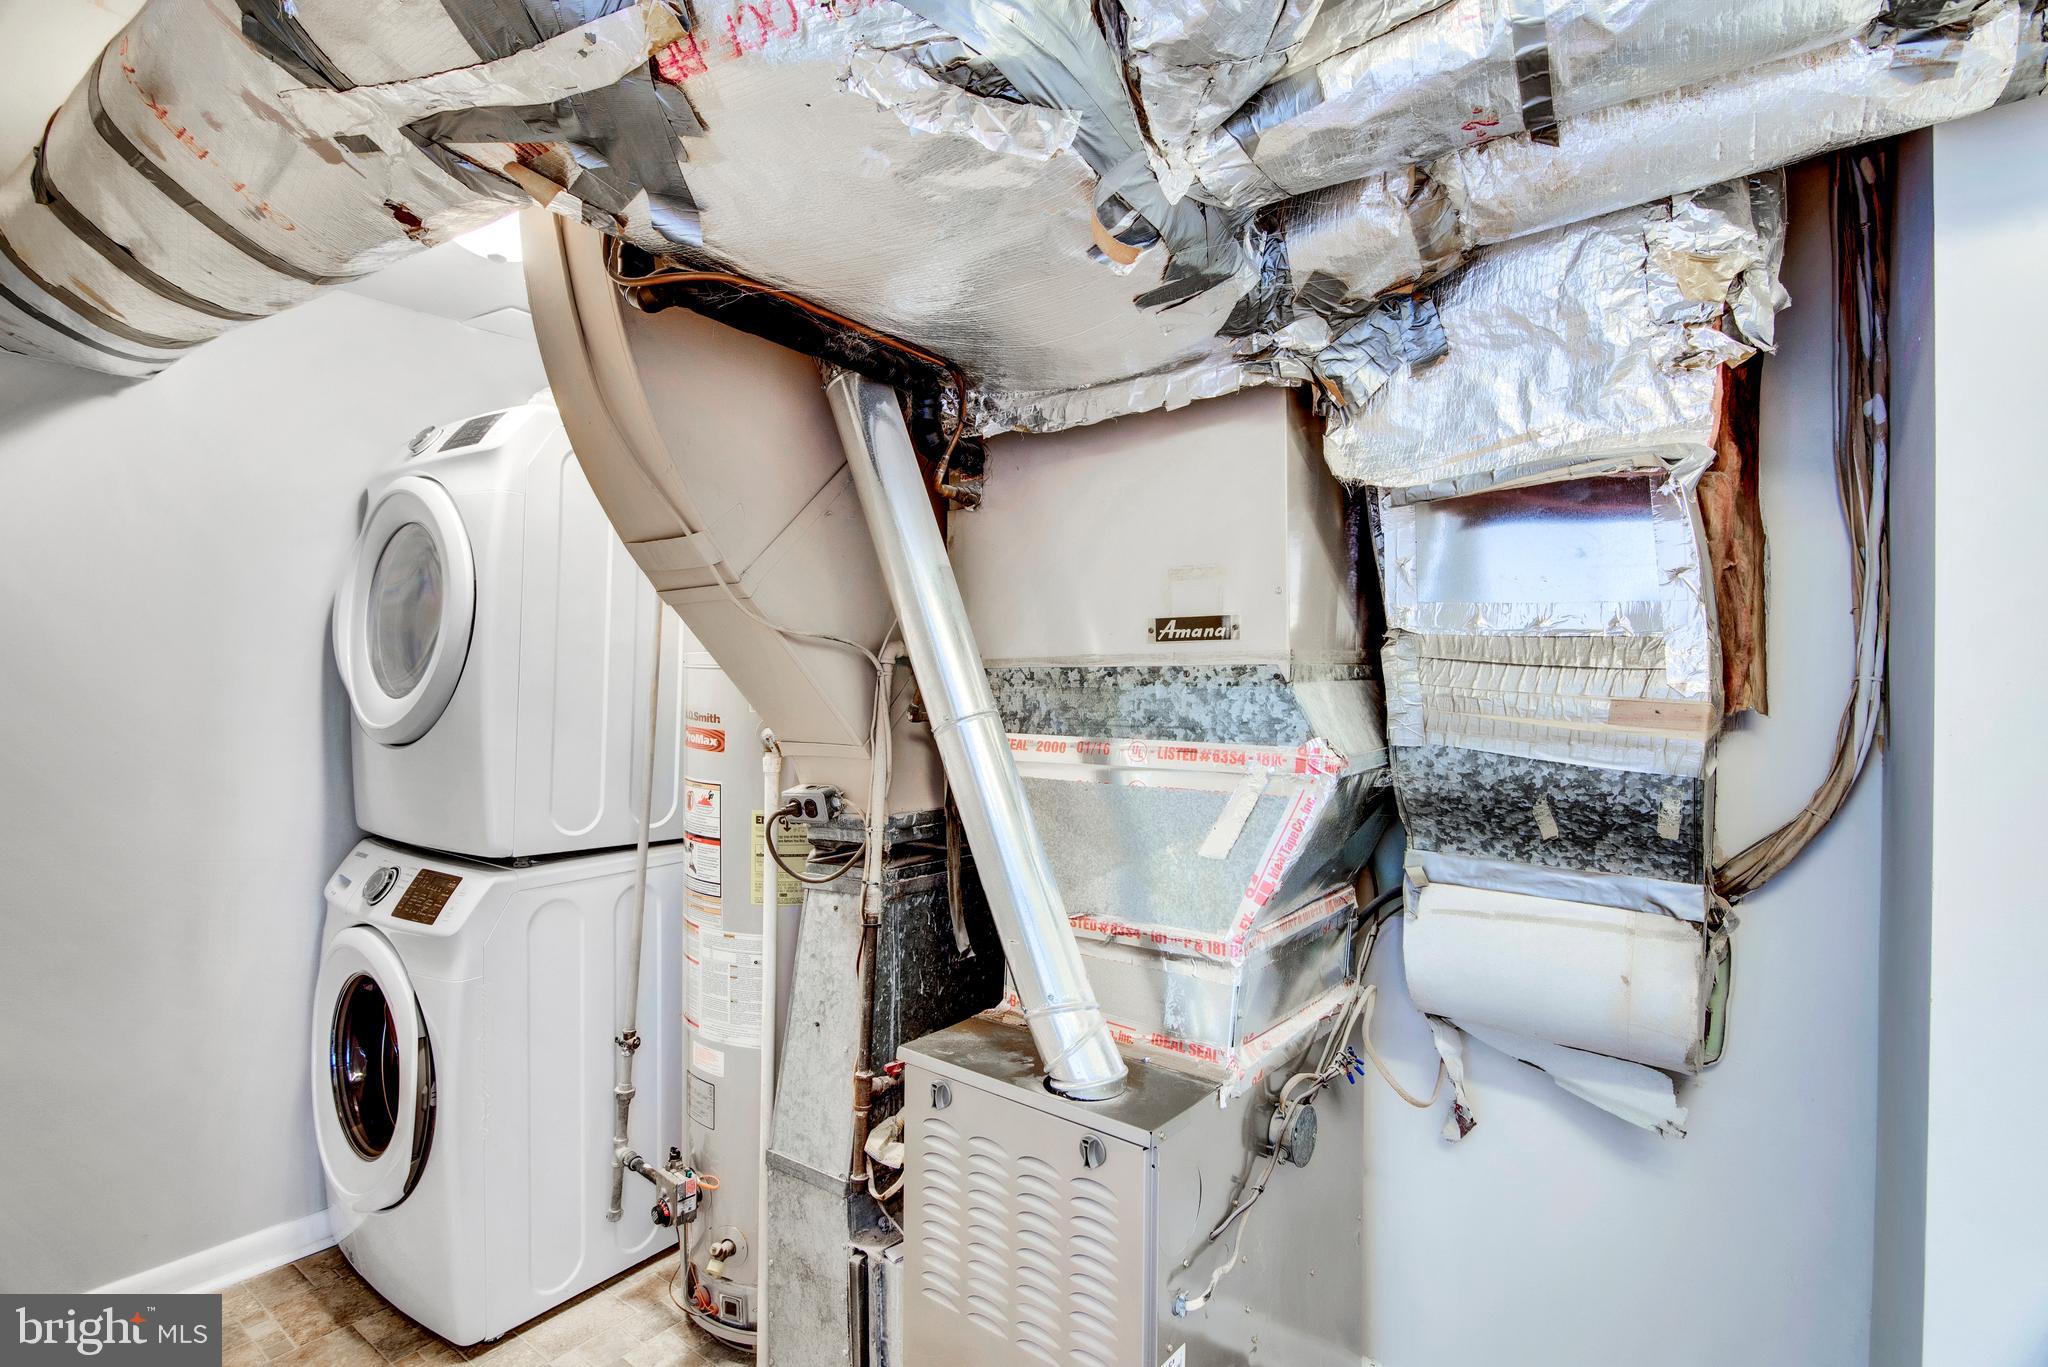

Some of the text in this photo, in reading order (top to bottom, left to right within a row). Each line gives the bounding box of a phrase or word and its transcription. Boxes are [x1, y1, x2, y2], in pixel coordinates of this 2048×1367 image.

[1157, 619, 1227, 641] Amana
[687, 733, 719, 747] roMax
[1008, 738, 1028, 751] EAL
[1035, 740, 1067, 753] 2000
[1076, 740, 1111, 757] 01/16
[1156, 746, 1198, 762] LISTED
[1279, 831, 1300, 854] Tape
[1151, 1033, 1186, 1054] IDEAL
